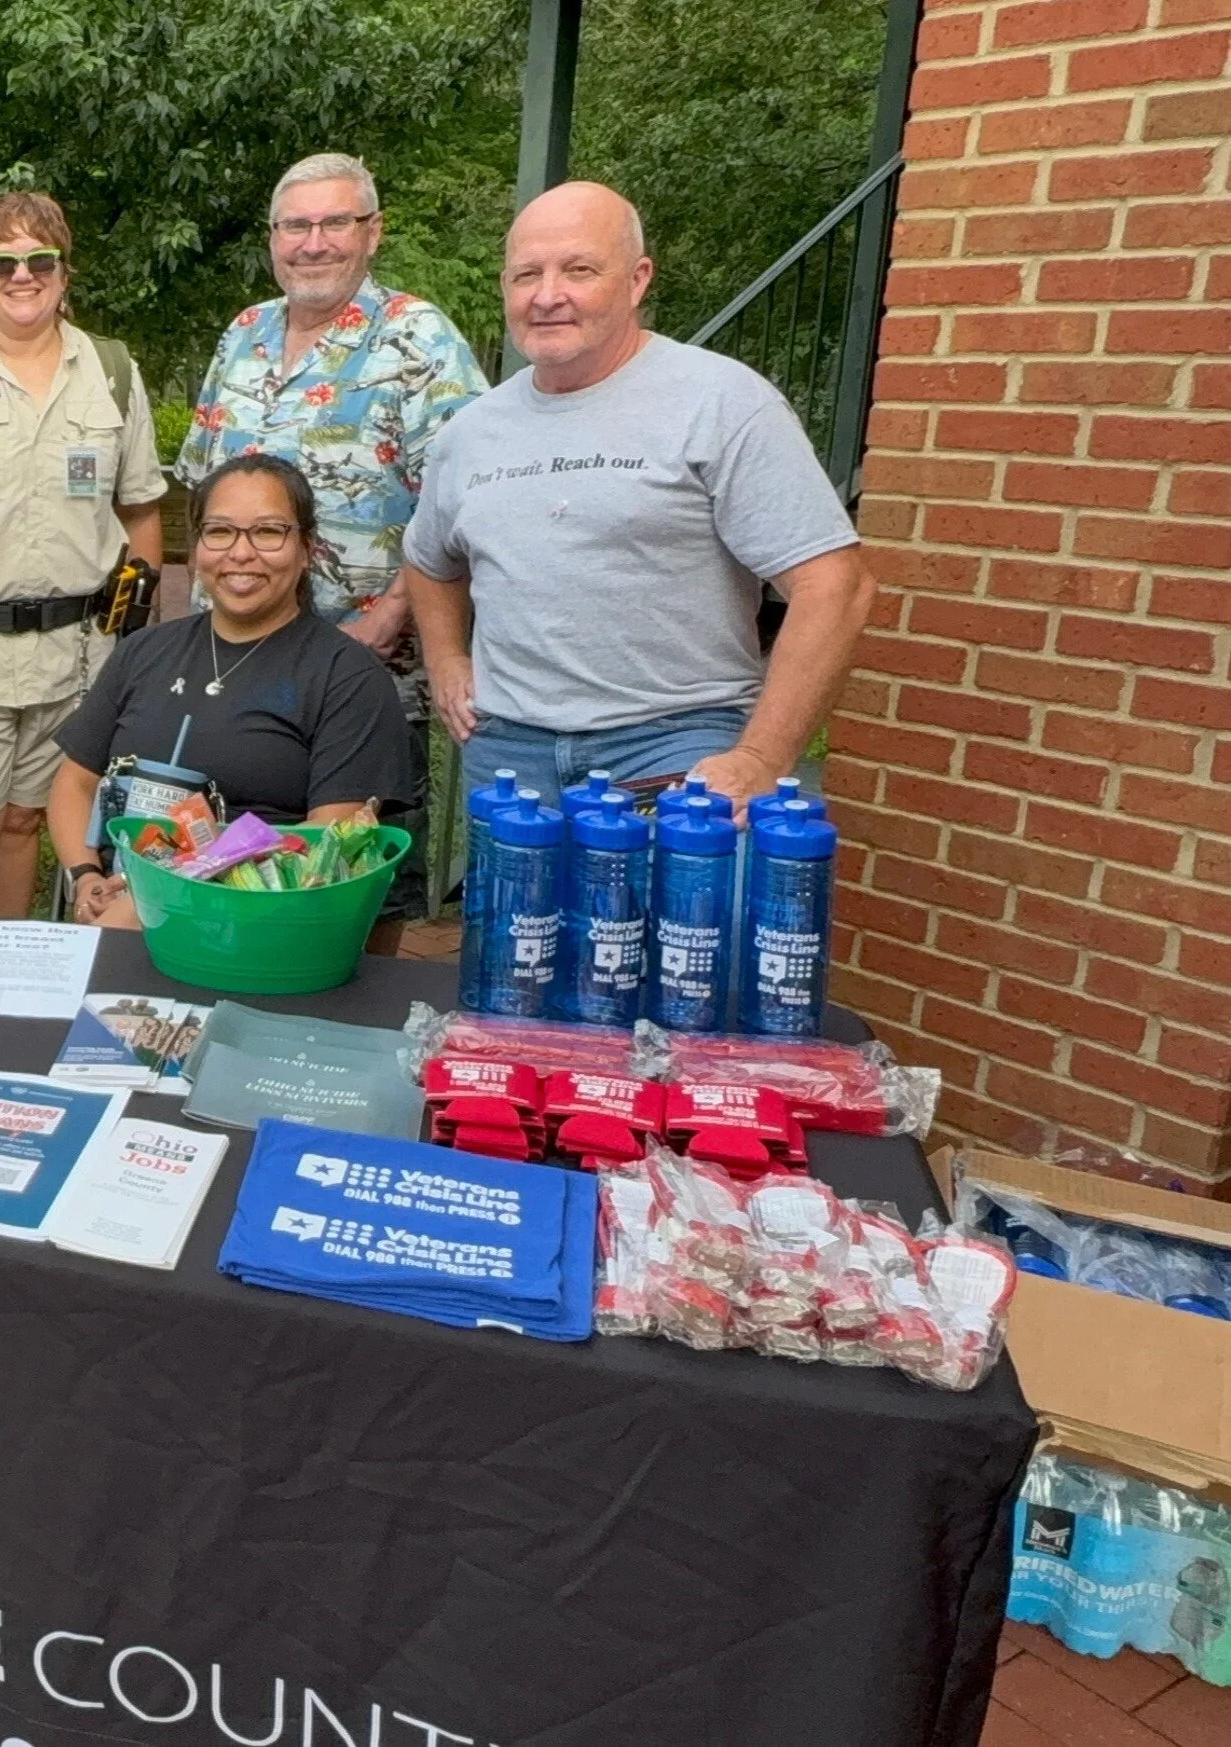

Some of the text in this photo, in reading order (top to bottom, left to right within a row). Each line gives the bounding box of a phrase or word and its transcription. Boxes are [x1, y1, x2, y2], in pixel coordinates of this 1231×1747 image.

[466, 453, 650, 491] Don't wait. Reach out.
[508, 924, 542, 938] Crisis
[587, 929, 624, 942] Crisis
[657, 931, 720, 948] Crisis Line
[658, 918, 720, 937] Veterans
[756, 923, 820, 943] Veterans
[754, 936, 820, 955] Crisis Line
[778, 985, 797, 997] 988
[131, 1129, 198, 1154] Ohio
[135, 1142, 185, 1161] MEANS
[120, 1151, 189, 1175] Jobs
[119, 1176, 164, 1194] County
[399, 1168, 520, 1200] Veterans
[343, 1187, 380, 1203] DIAL
[383, 1193, 412, 1208] 988
[415, 1199, 446, 1214] then
[448, 1204, 496, 1221] PRESS
[394, 1181, 520, 1212] Crisis Line
[383, 1226, 513, 1258] Veterans
[322, 1241, 362, 1260] DIAL
[366, 1250, 395, 1265] 988
[400, 1256, 433, 1270] then
[435, 1261, 486, 1277] PRESS
[376, 1239, 513, 1270] Crisis Line
[1012, 1555, 1183, 1603] RIFIED WATER
[33, 1630, 476, 1747] COUNT
